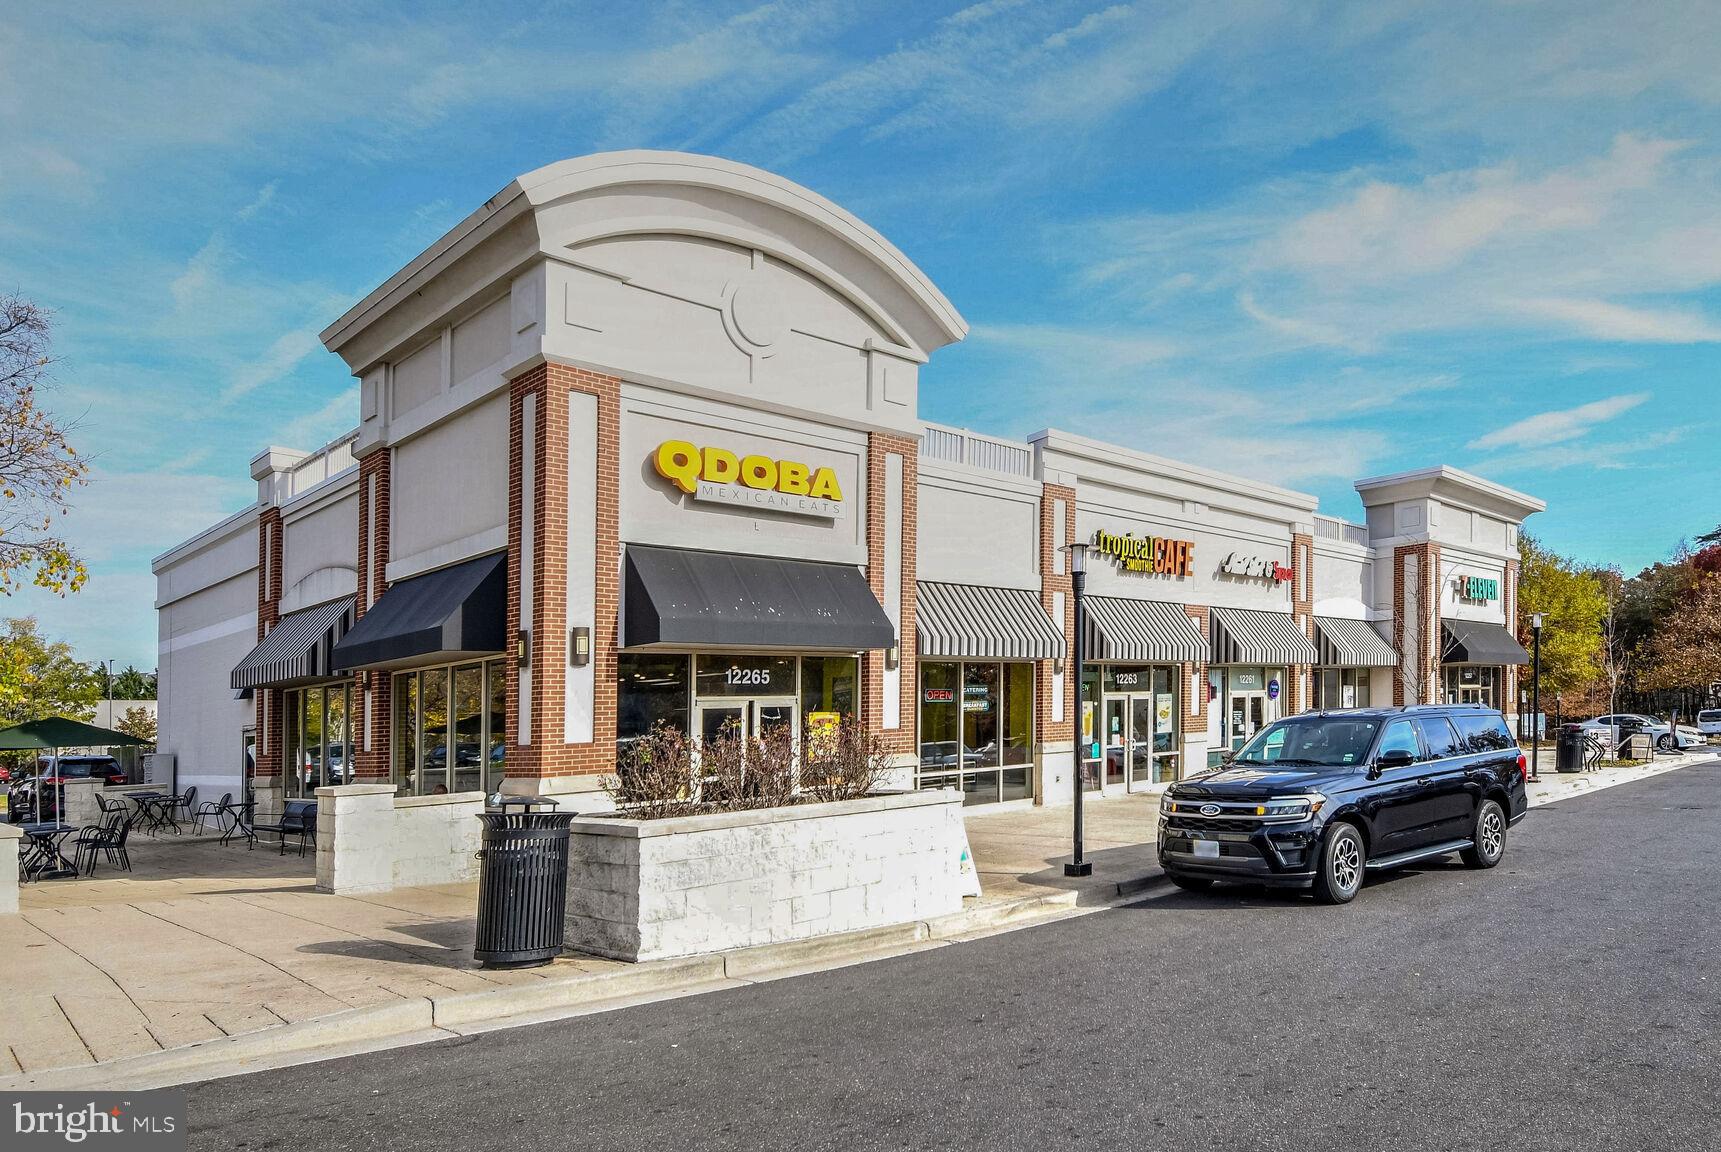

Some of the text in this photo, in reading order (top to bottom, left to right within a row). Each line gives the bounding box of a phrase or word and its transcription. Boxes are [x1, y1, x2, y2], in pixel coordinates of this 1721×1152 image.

[654, 439, 843, 501] QDOBA
[702, 485, 842, 514] MEXICAN EATS
[1098, 528, 1154, 562] tropical
[1154, 536, 1195, 577] CAFE
[1126, 558, 1154, 573] SMOOTHIE
[725, 668, 770, 685] 12265
[1115, 673, 1138, 685] 12263
[1239, 674, 1255, 684] 12261
[927, 690, 953, 700] OPEN
